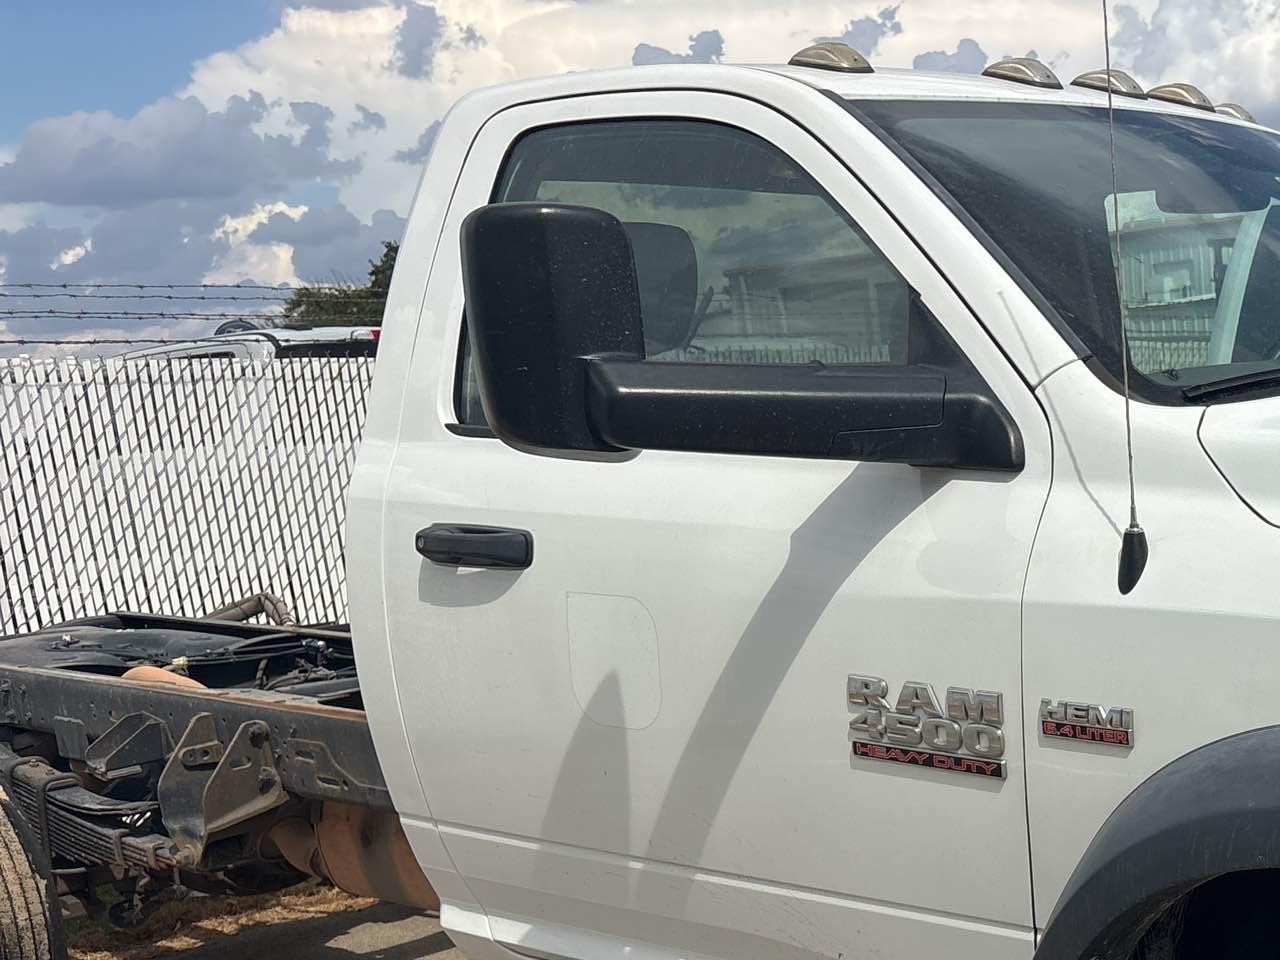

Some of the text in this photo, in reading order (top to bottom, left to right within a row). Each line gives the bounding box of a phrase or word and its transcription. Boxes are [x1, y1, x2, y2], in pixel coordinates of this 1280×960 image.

[847, 673, 1004, 724] RAM
[1040, 698, 1134, 730] HEMI
[848, 708, 1006, 758] 4500
[1043, 722, 1130, 745] 6.4 LITER
[855, 742, 998, 775] HEAVY DUTY
